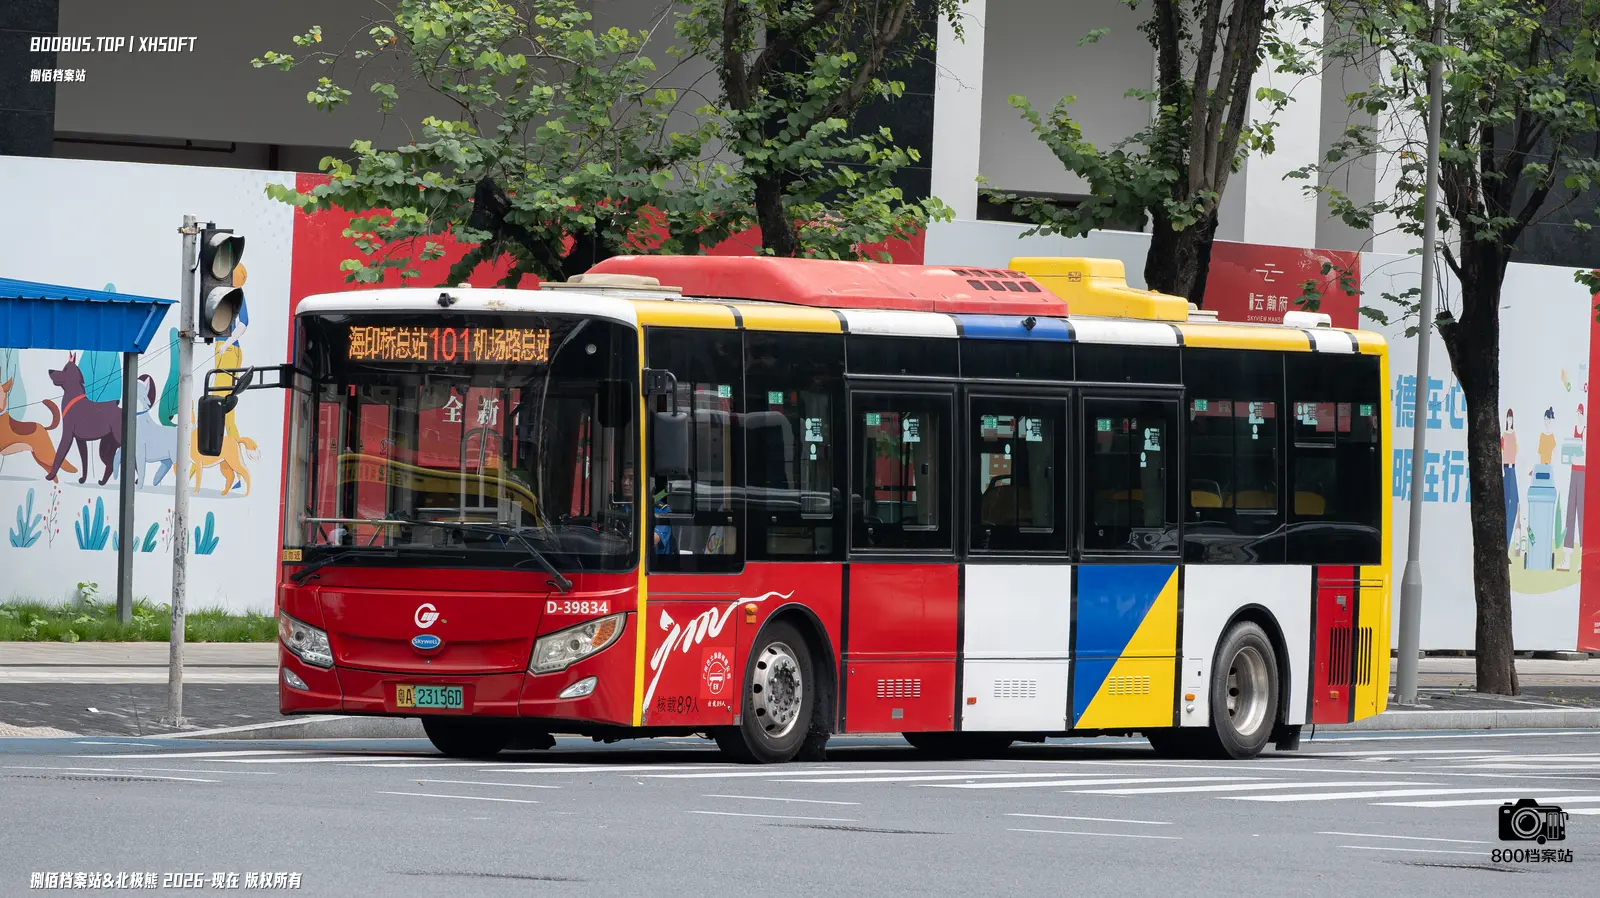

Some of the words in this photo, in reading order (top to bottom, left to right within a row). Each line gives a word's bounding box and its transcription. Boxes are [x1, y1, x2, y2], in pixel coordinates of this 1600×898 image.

[348, 326, 428, 361] 海印桥总站
[429, 327, 470, 361] 101
[473, 328, 550, 362] 机场路总站
[546, 600, 609, 615] D-39834
[397, 687, 413, 705] 粤A
[418, 688, 462, 706] 23156D
[657, 695, 700, 714] 核载89人
